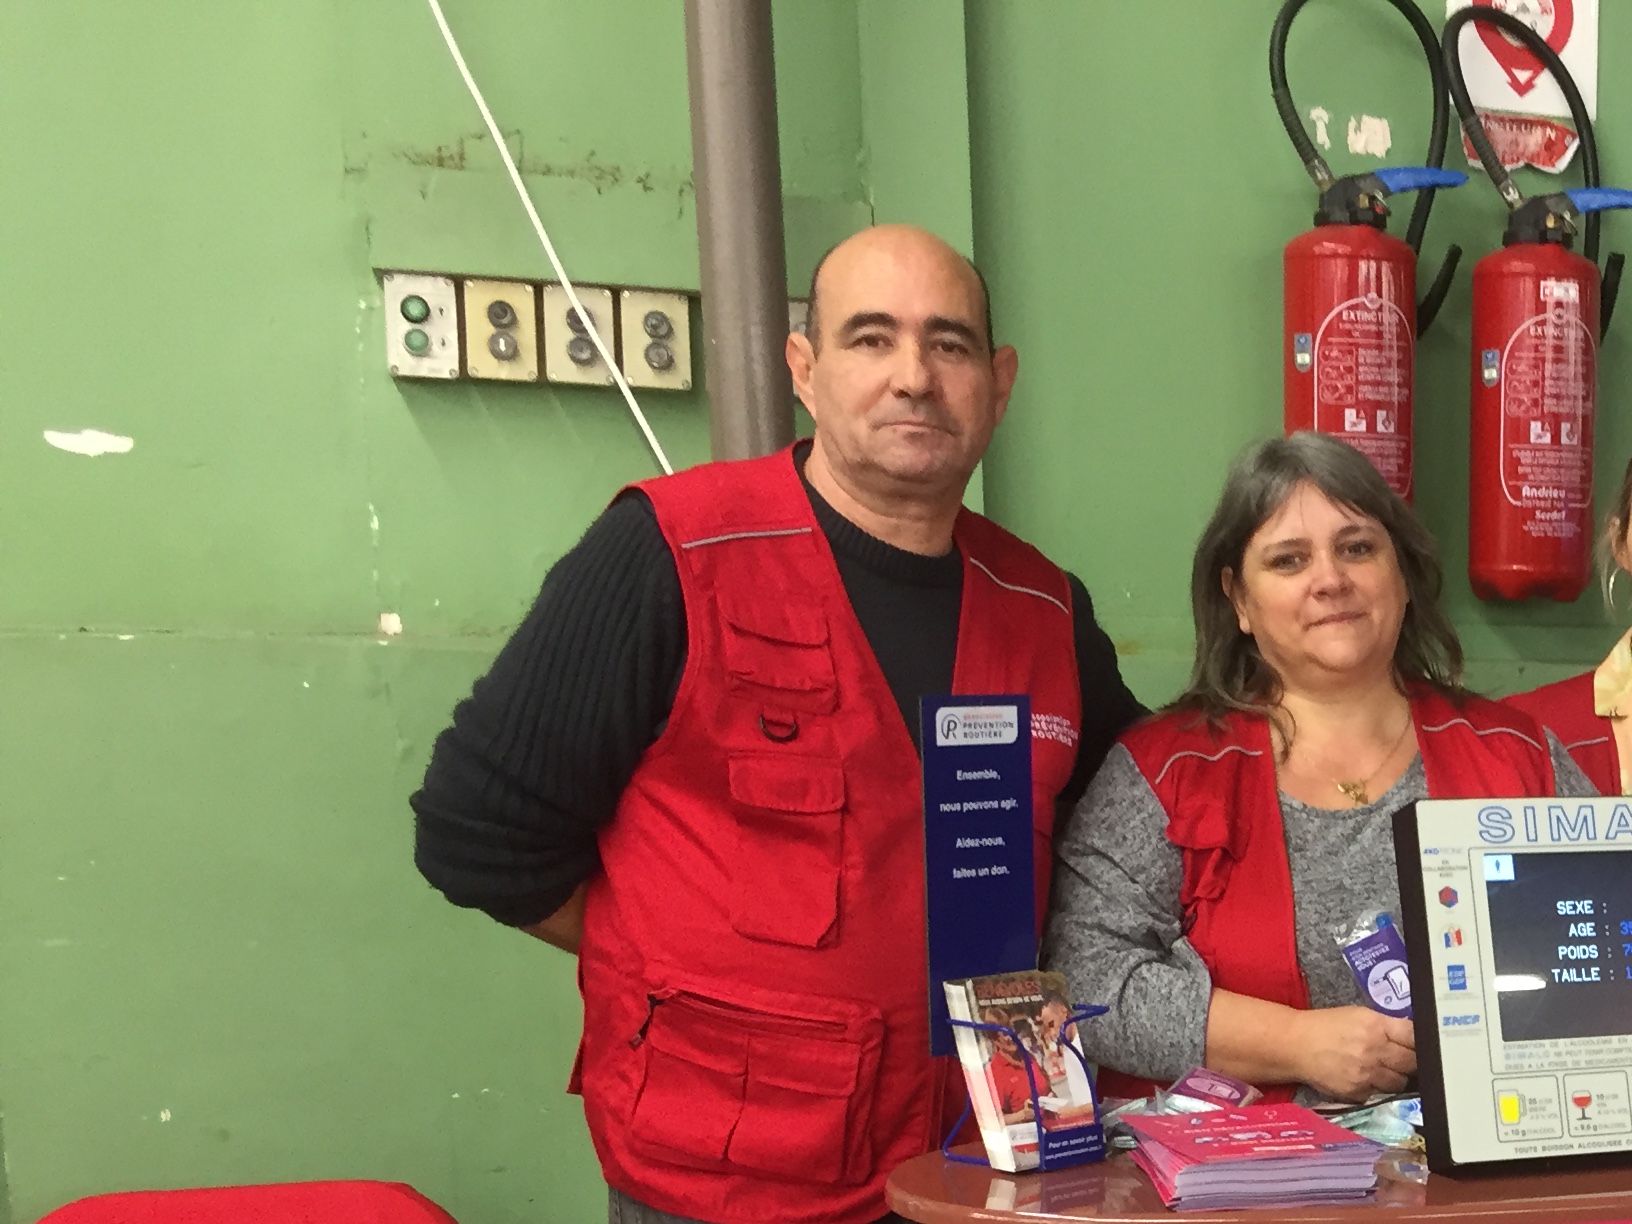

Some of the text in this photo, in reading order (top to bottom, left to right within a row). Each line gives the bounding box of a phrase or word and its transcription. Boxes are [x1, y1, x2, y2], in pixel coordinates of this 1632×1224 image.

[962, 721, 1014, 730] PRÉVENTION
[940, 801, 961, 812] nous
[963, 799, 999, 813] pouvons
[953, 868, 977, 879] faites
[978, 868, 990, 876] un
[1556, 900, 1595, 915] SEXE
[1568, 922, 1597, 938] AGE
[1557, 945, 1599, 960] POIDS
[1551, 967, 1602, 983] TAILLE
[1514, 1146, 1538, 1154] TOUTE
